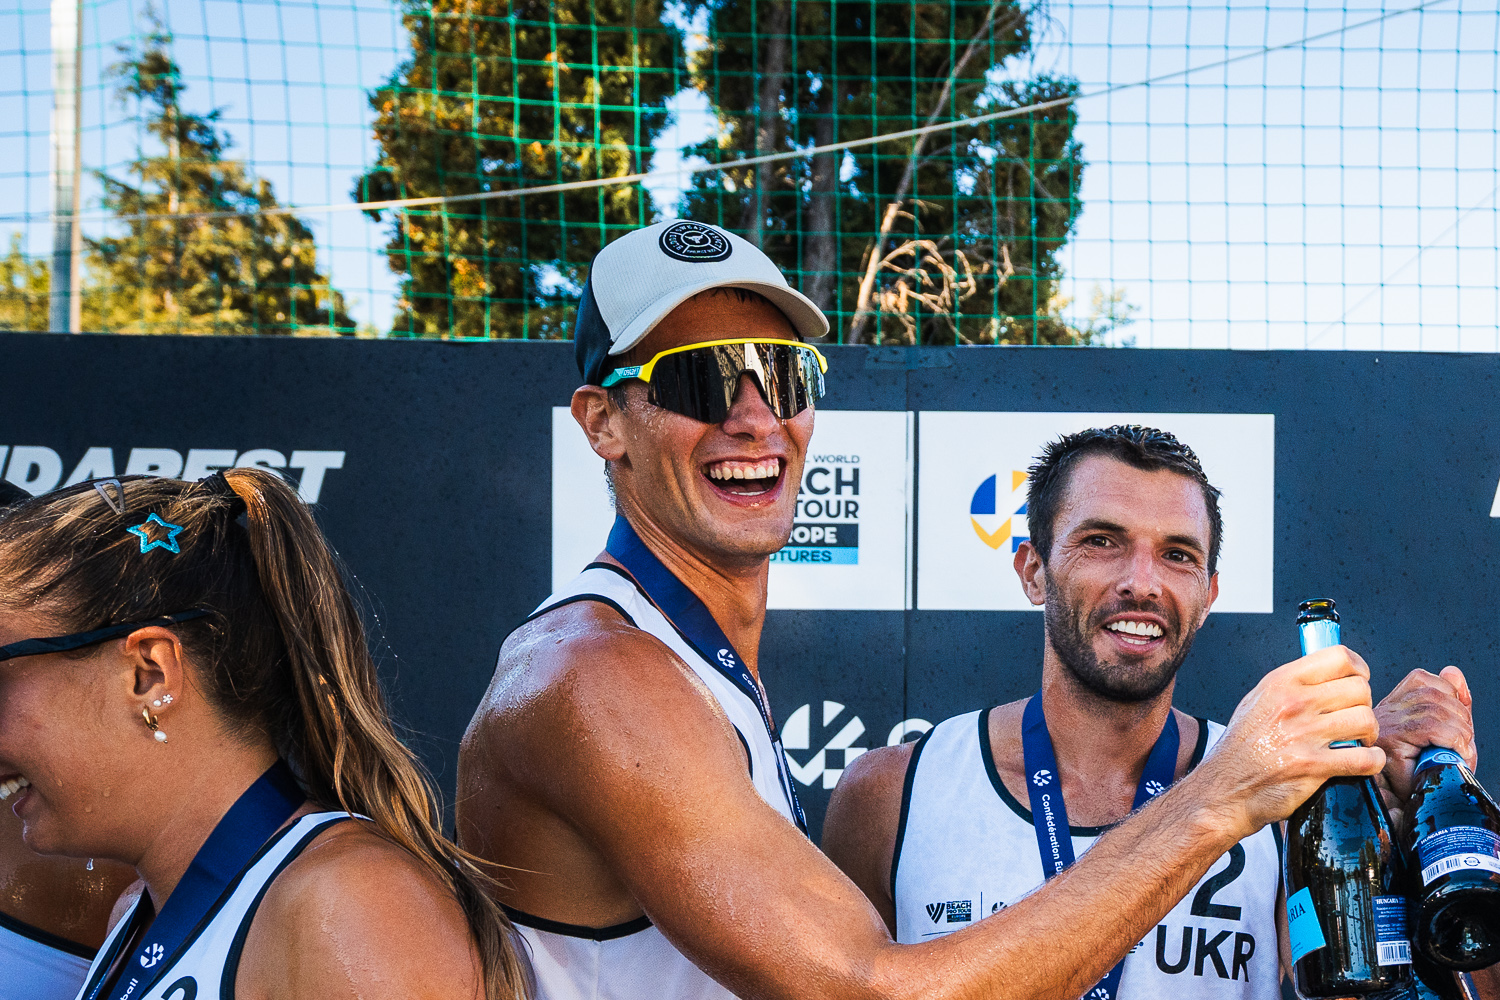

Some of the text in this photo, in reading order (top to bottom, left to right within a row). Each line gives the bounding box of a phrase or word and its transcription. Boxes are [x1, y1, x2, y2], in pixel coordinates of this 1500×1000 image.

[813, 455, 860, 464] WORLD
[794, 499, 860, 519] TOUR
[1041, 793, 1061, 860] Confédération
[1420, 828, 1449, 845] HUNGARIA
[1189, 842, 1247, 922] 2
[946, 902, 972, 910] BEACH
[1155, 923, 1256, 983] UKR
